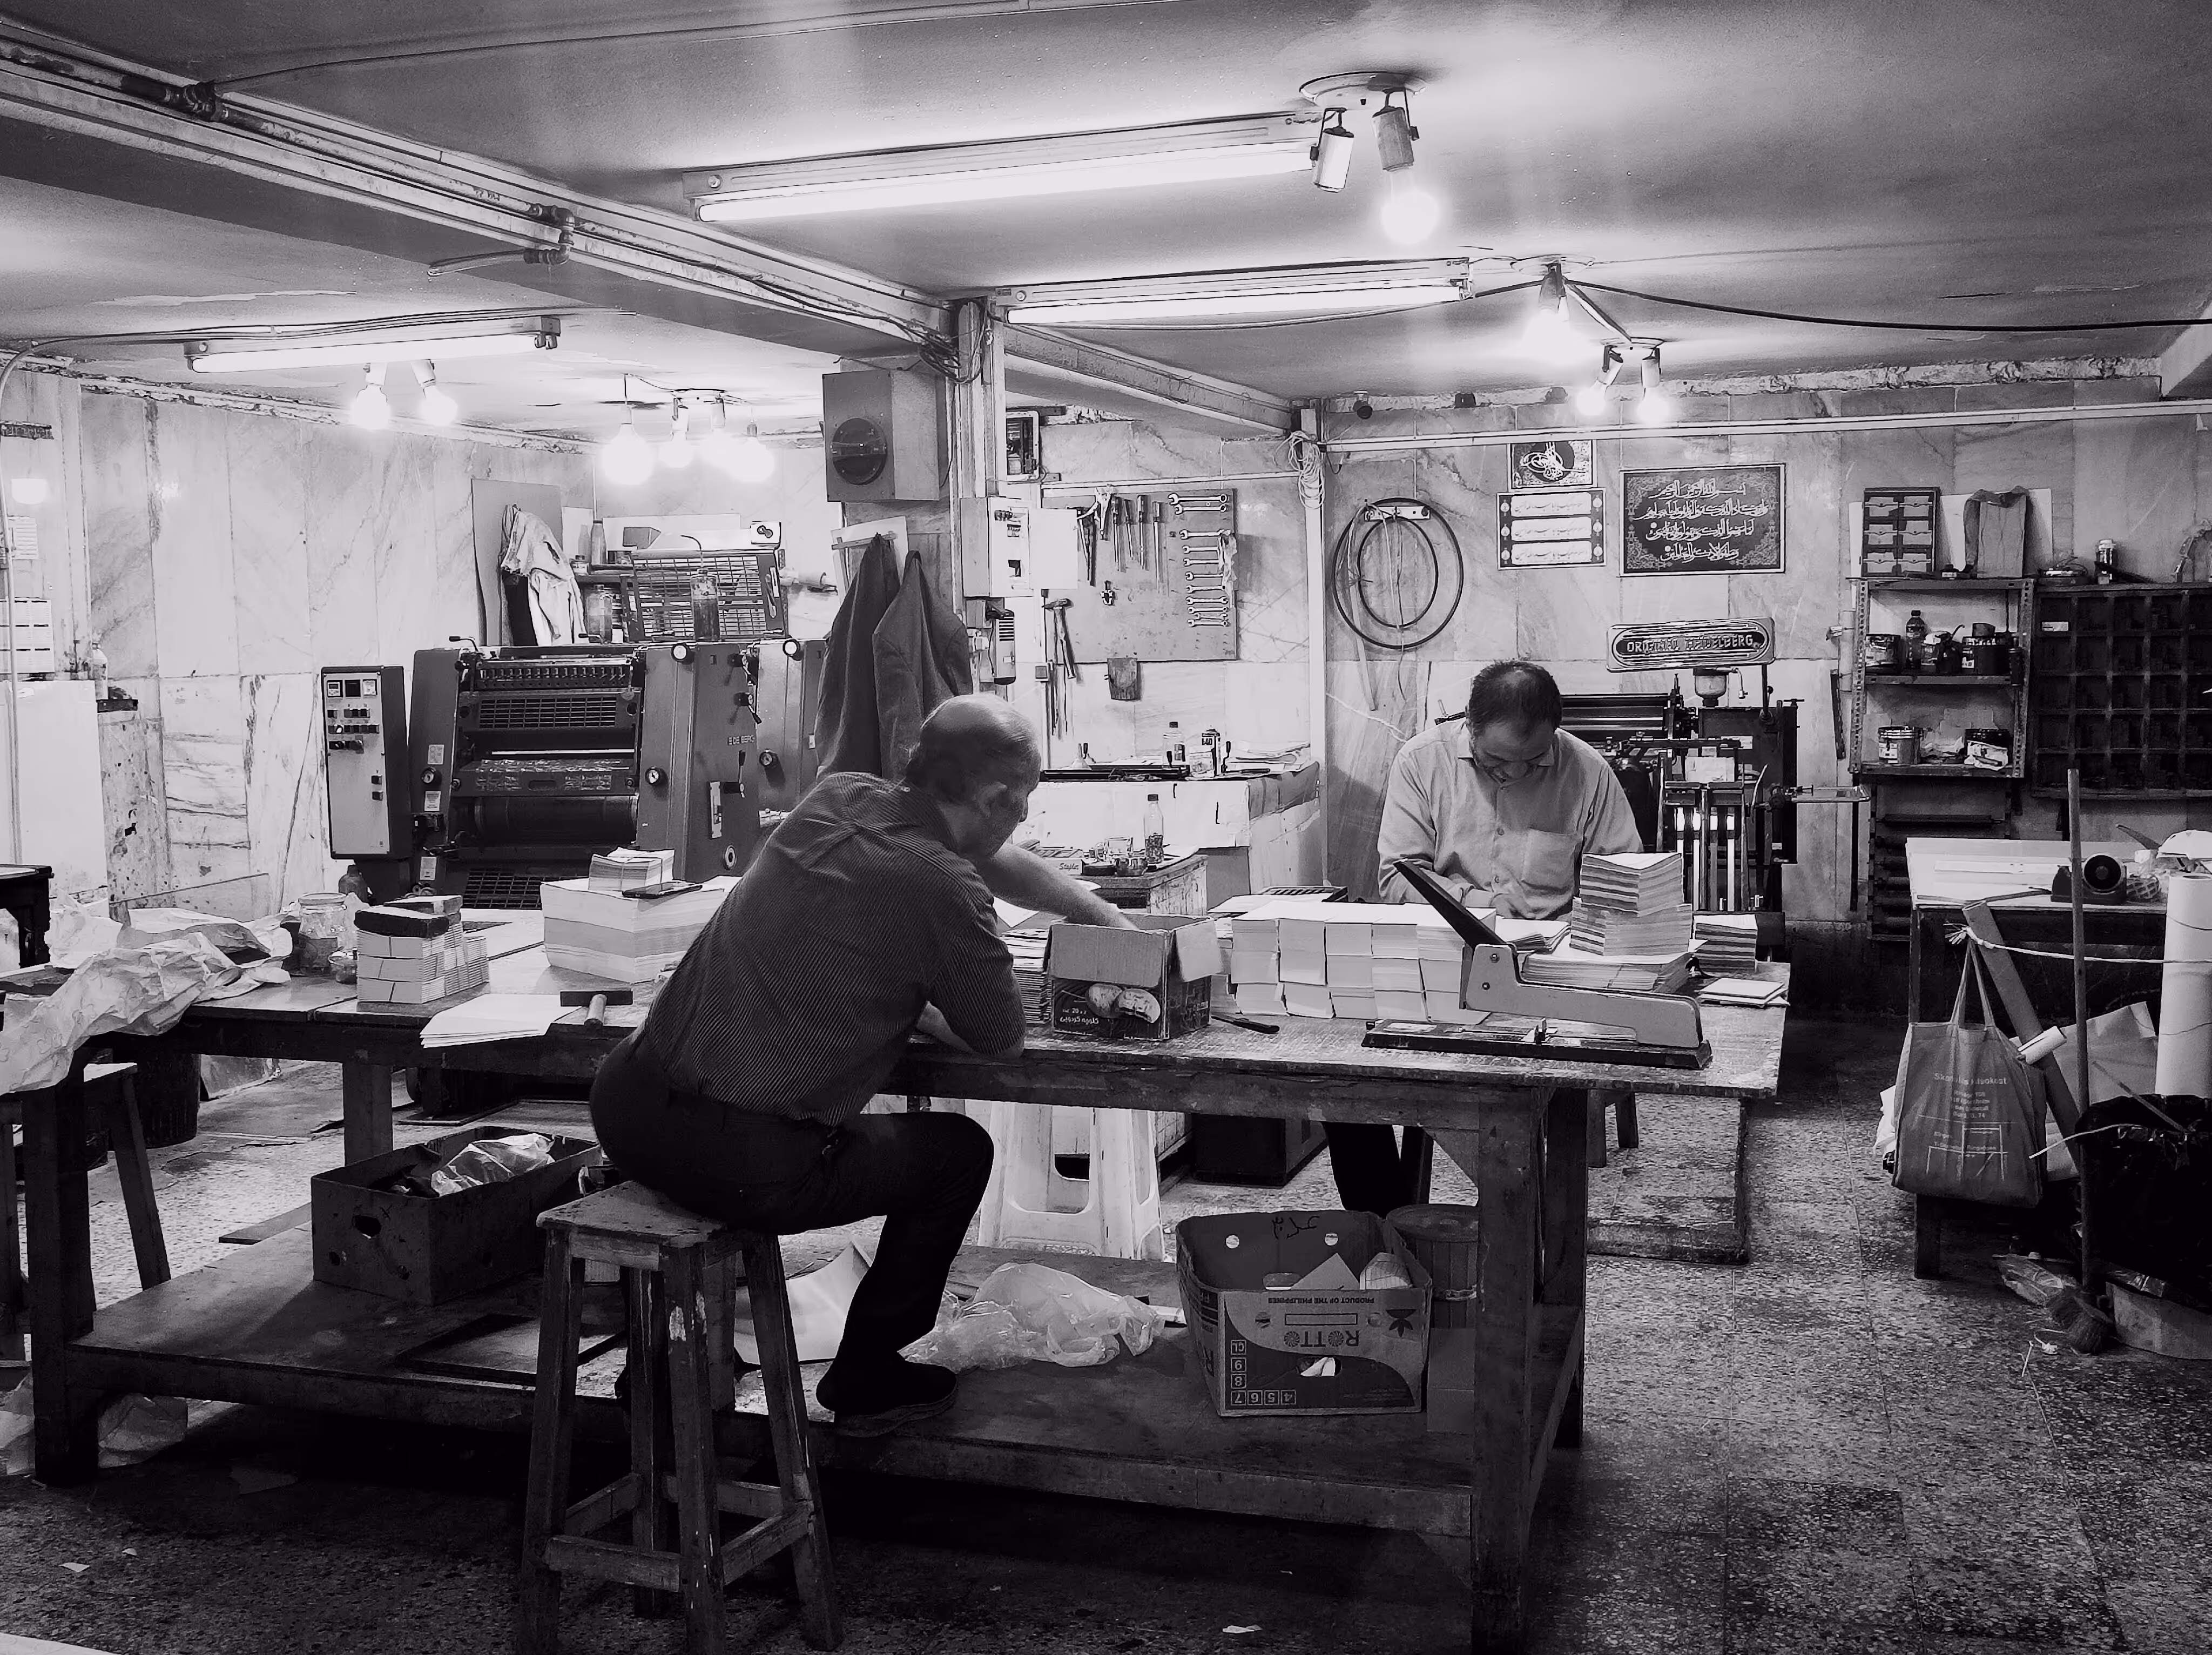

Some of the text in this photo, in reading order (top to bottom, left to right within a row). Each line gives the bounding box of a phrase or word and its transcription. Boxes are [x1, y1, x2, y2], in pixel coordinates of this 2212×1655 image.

[1627, 633, 1754, 652] ORIGINAL HEIDELBERG
[1284, 1330, 1360, 1348] ROTTO
[1235, 1360, 1242, 1370] 9
[1235, 1376, 1243, 1387] 8
